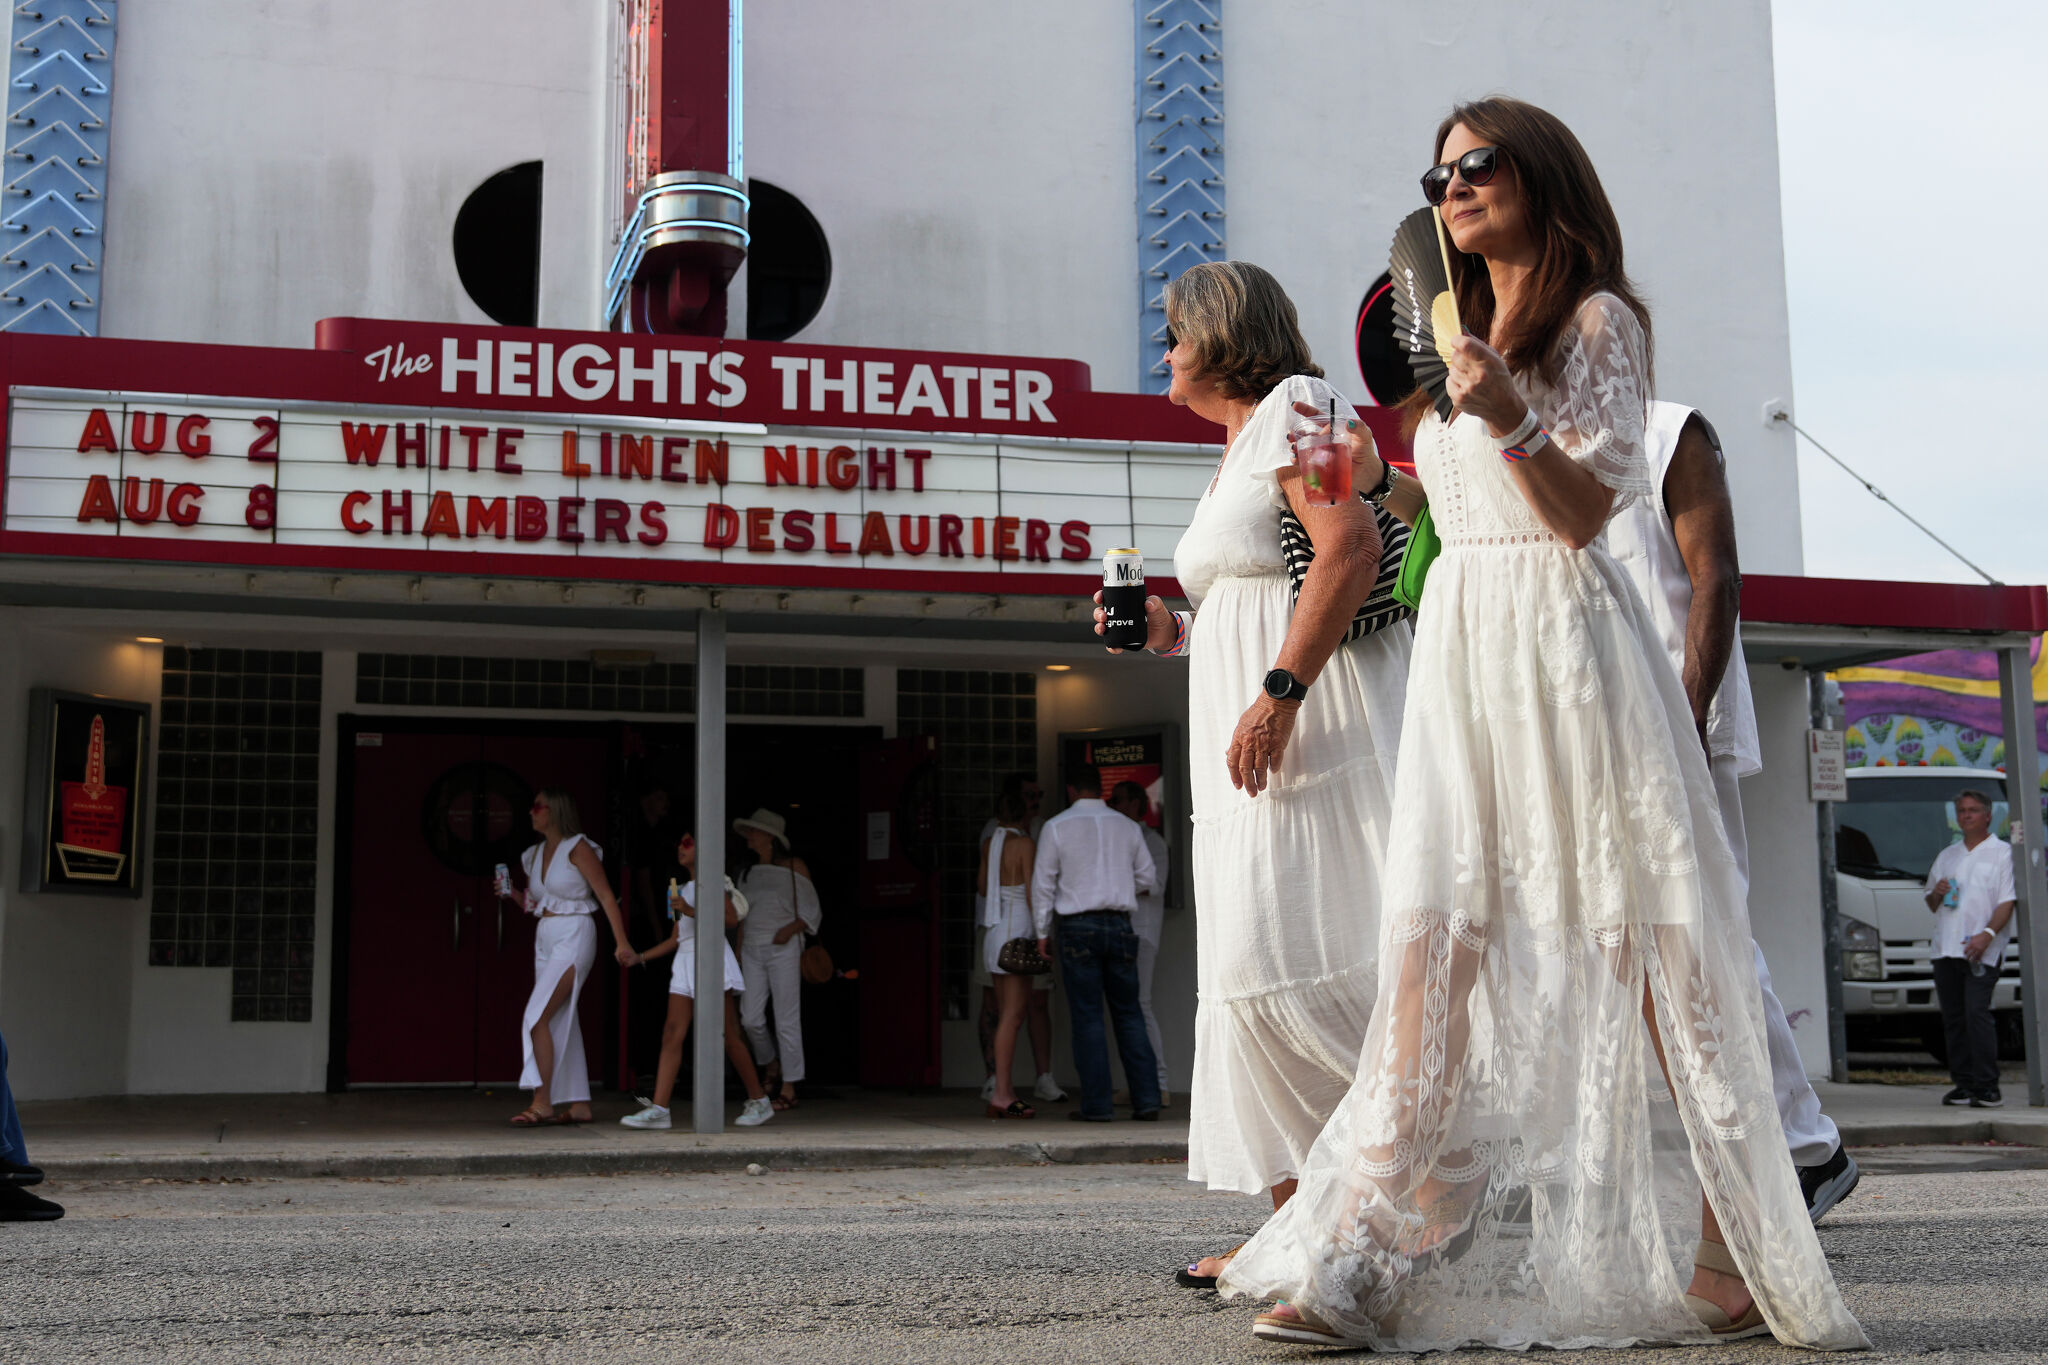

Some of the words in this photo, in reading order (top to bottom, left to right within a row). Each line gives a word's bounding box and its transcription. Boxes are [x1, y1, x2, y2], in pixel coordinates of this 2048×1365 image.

[363, 341, 433, 382] The
[440, 337, 747, 408] HEIGHTS
[771, 355, 1058, 423] THEATER
[77, 408, 212, 459] AUG
[247, 416, 280, 463] 2
[341, 420, 525, 475] WHITE
[561, 430, 729, 486] LINEN
[763, 444, 932, 492] NIGHT
[77, 475, 206, 527] AUG
[244, 484, 278, 530] 8
[340, 489, 668, 547] CHAMBERS
[703, 502, 1092, 562] DESLAURIERS
[1095, 744, 1144, 754] HEIGHTS
[1096, 753, 1144, 762] THEATER
